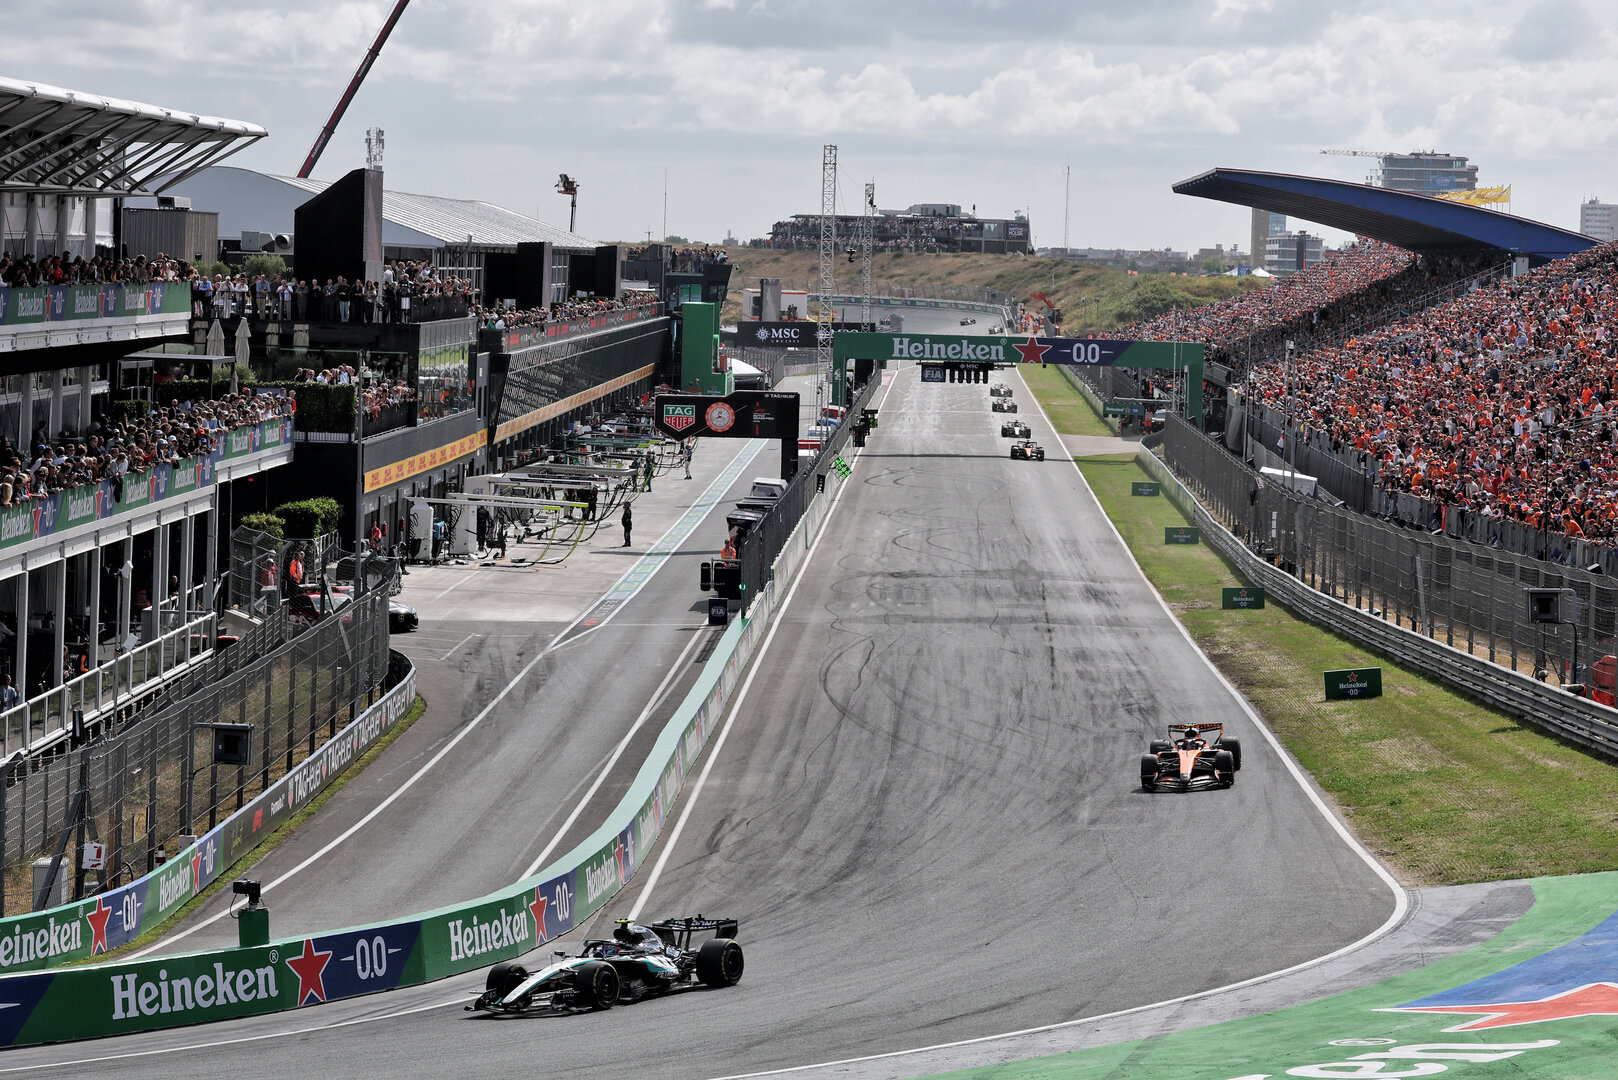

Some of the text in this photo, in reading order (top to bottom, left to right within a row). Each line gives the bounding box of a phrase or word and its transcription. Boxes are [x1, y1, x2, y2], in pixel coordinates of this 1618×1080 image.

[18, 293, 43, 317] Heineken
[75, 290, 97, 313] Heineken
[125, 288, 144, 310] Heineken
[771, 328, 800, 338] MSC
[892, 337, 1100, 363] Heineken 0.0
[924, 369, 943, 379] FIA
[665, 417, 694, 430] HEUER
[667, 407, 692, 415] TAG
[2, 508, 31, 541] Heineken
[68, 492, 94, 522] Heineken
[126, 477, 148, 505] Heineken
[175, 462, 195, 489] Heineken
[0, 917, 81, 968] eineken
[159, 863, 190, 912] Heineken
[111, 963, 279, 1020] Heineken
[356, 936, 387, 979] 0.0
[448, 908, 529, 961] Heineken
[555, 882, 570, 922] 0.0
[585, 854, 616, 904] Heineken
